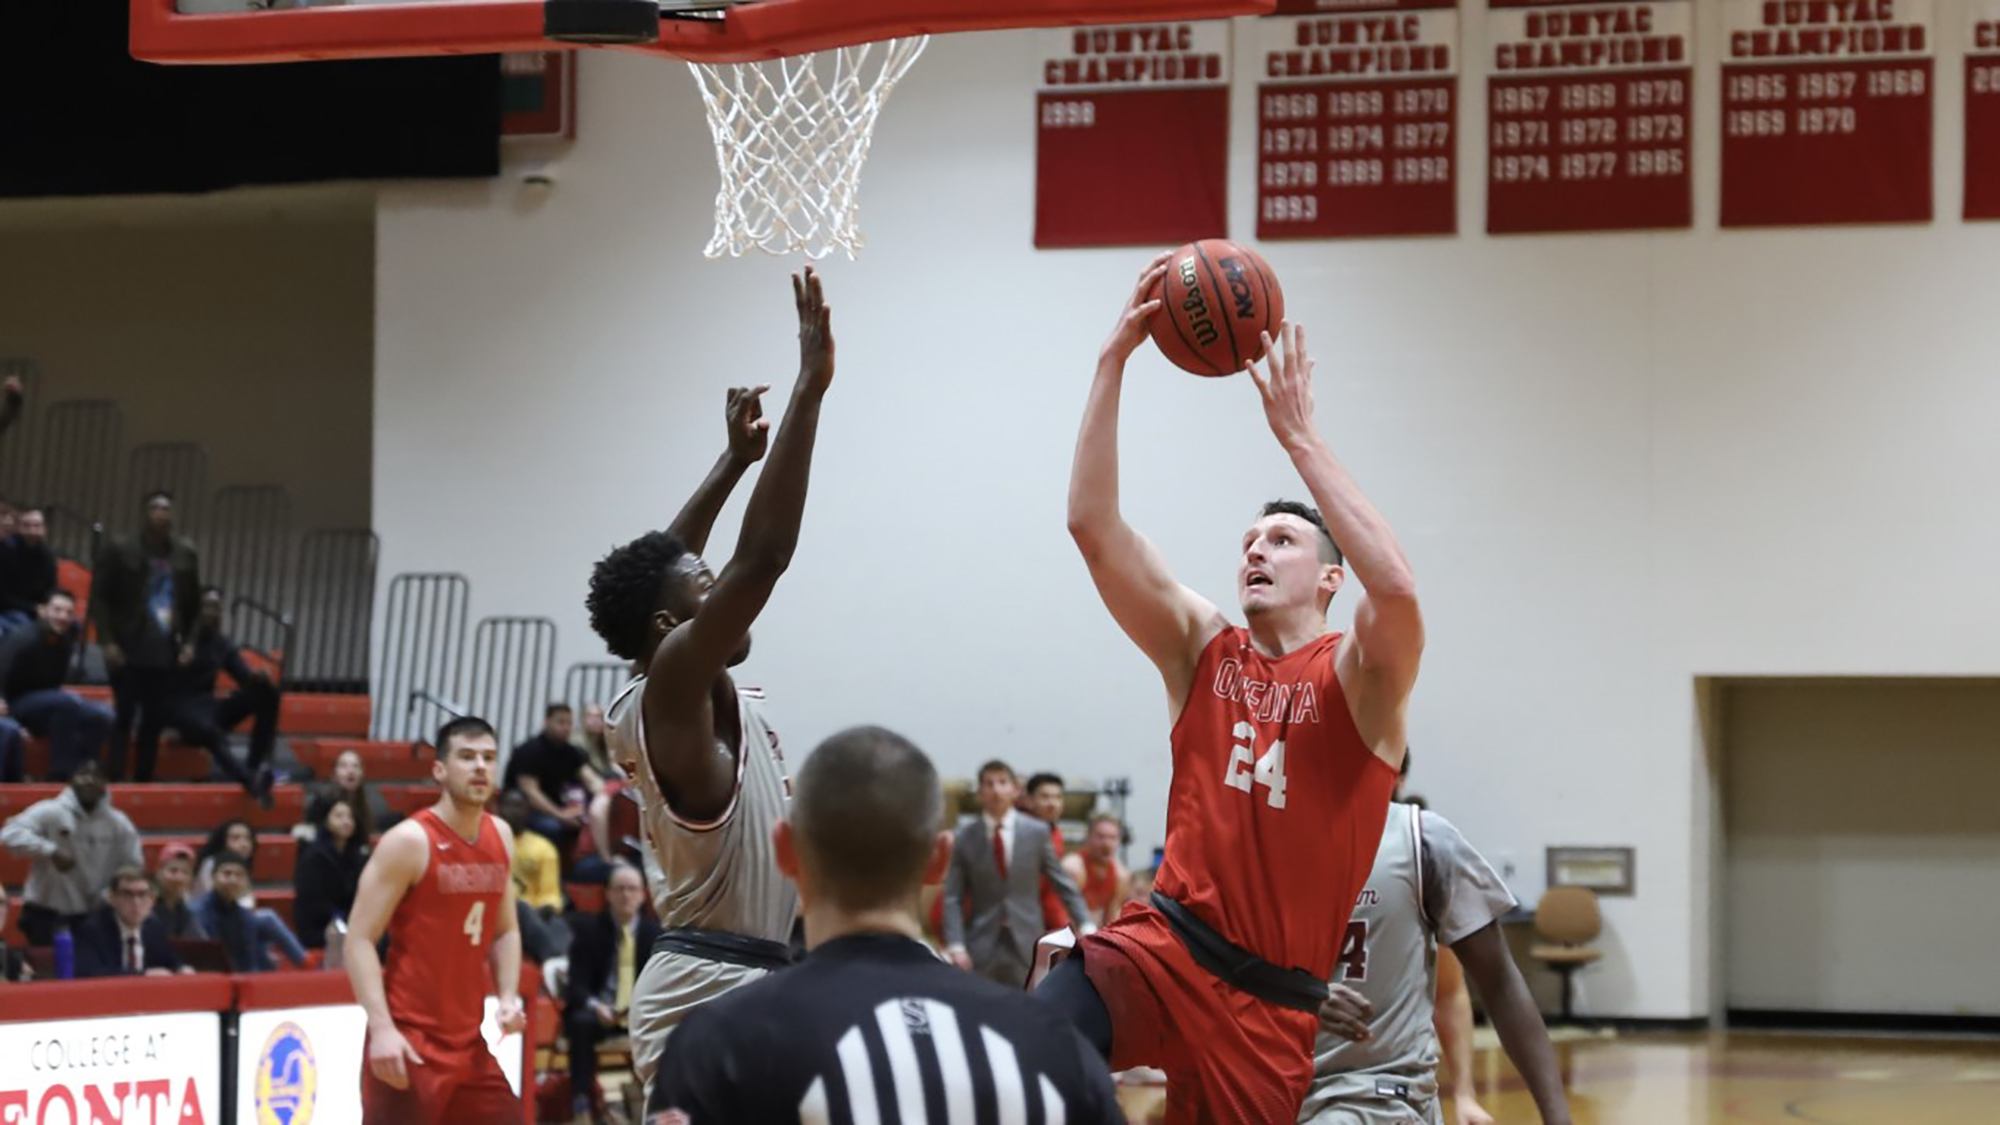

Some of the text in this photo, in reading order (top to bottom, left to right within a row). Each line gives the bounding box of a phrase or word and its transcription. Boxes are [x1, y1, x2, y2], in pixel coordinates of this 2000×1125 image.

[1496, 35, 1684, 70] CHAMPIONS
[1731, 24, 1925, 57] CHAMPIONS
[1045, 53, 1221, 85] CHAMPIONS
[1267, 44, 1450, 77] CHAMPIONS
[1179, 255, 1219, 347] Wilson
[1213, 657, 1320, 724] ONEONA
[1224, 720, 1287, 810] 24
[463, 900, 485, 946] 4
[31, 1032, 167, 1071] COLLEGE AT
